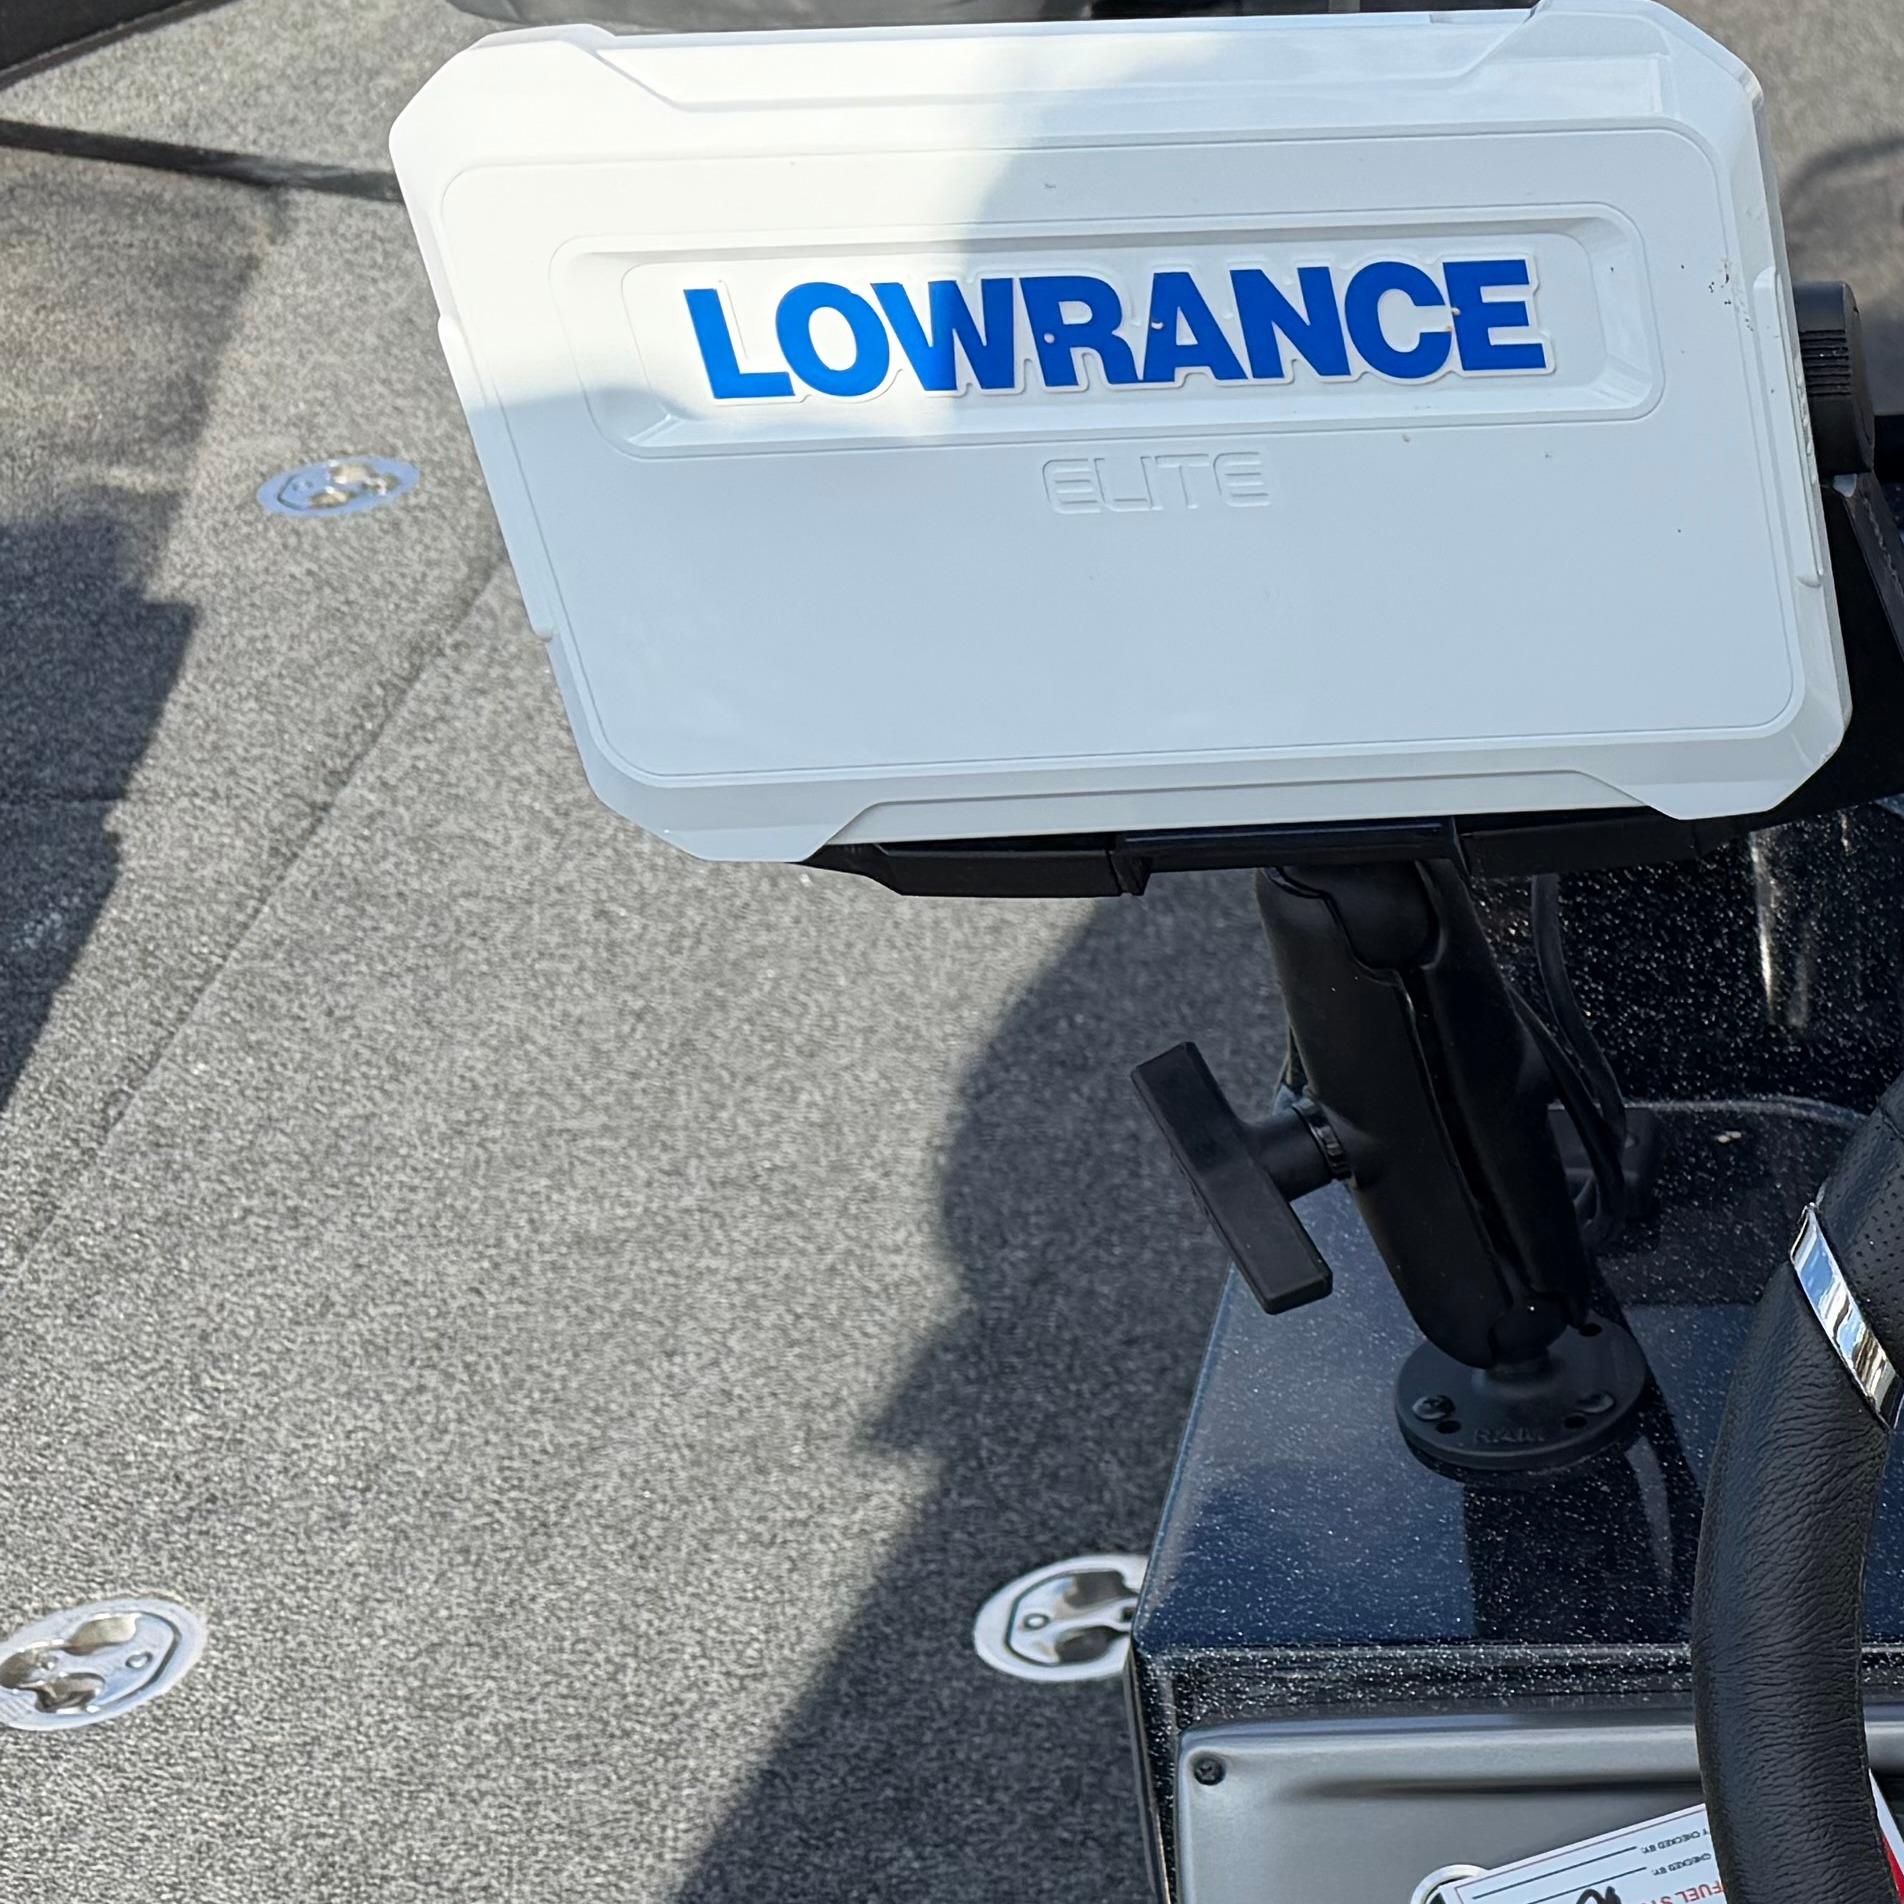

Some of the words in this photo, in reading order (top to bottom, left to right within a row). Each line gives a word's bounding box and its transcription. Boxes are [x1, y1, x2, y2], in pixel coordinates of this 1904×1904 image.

[683, 259, 1546, 399] LOWRANCE
[1042, 452, 1271, 514] ELITE
[1675, 1880, 1724, 1903] FUEL
